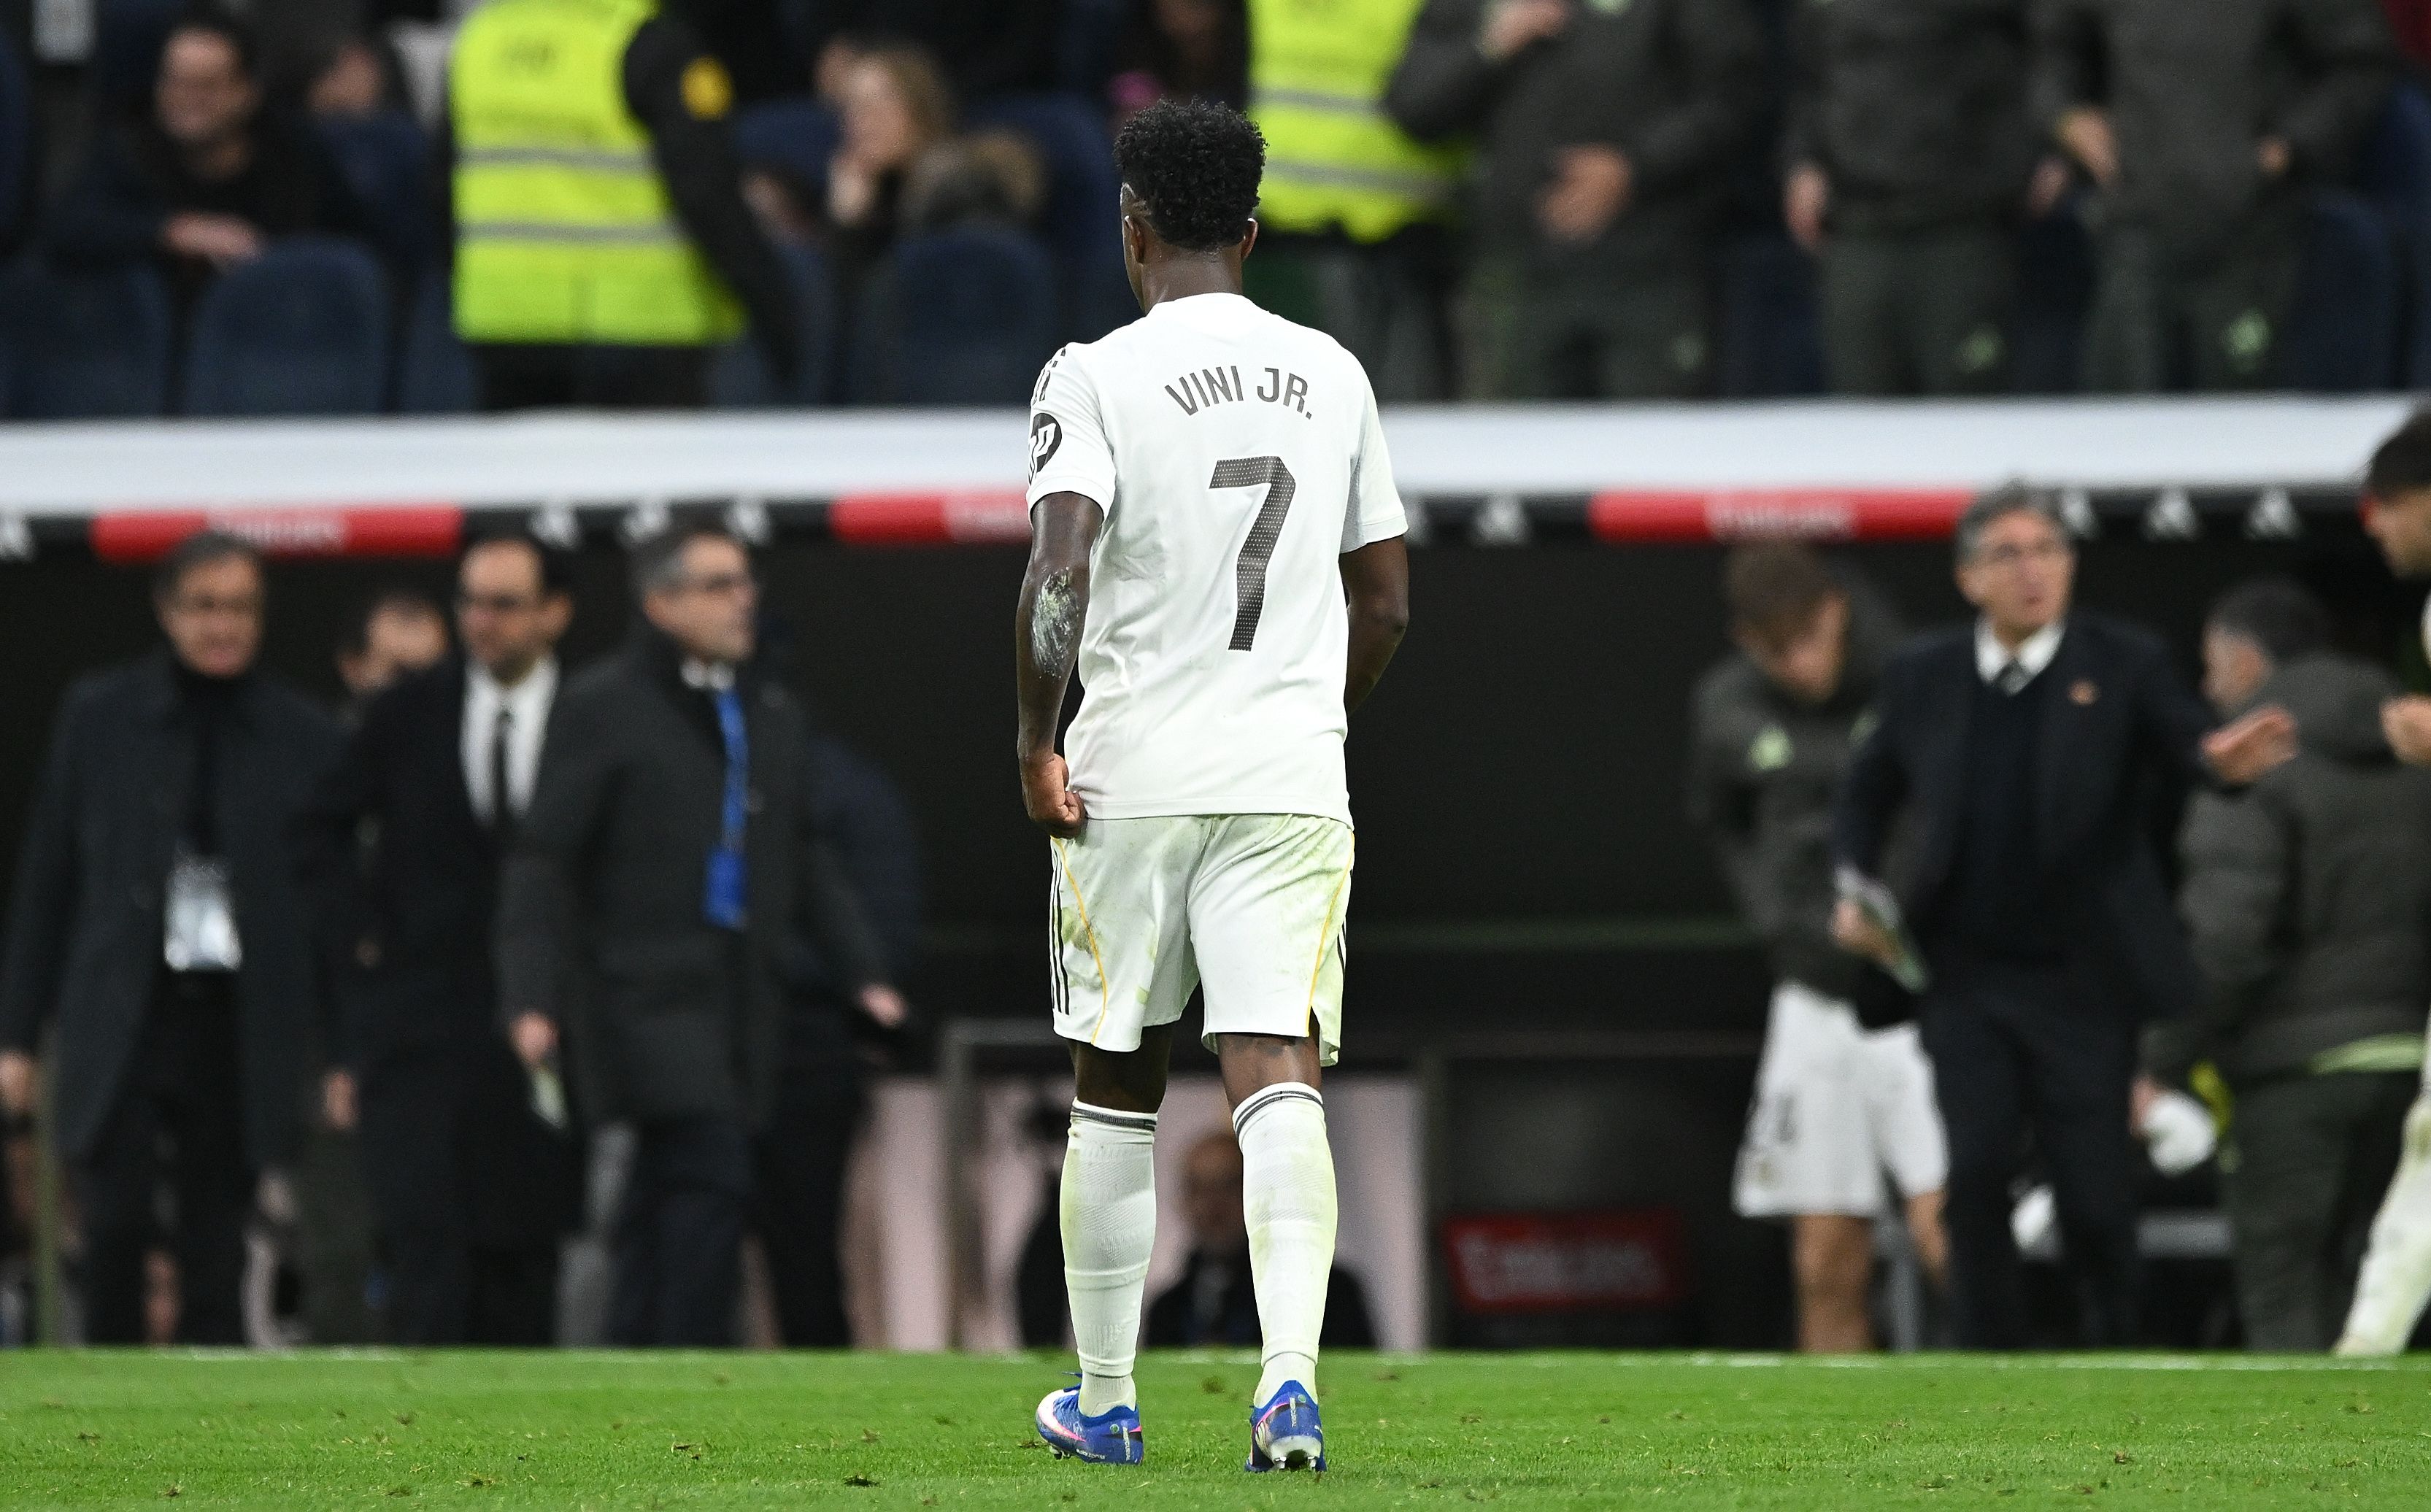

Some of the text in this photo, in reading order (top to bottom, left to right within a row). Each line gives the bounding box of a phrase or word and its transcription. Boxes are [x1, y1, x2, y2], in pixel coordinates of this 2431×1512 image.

[1164, 365, 1312, 420] VINI JR.
[1209, 455, 1296, 652] 7
